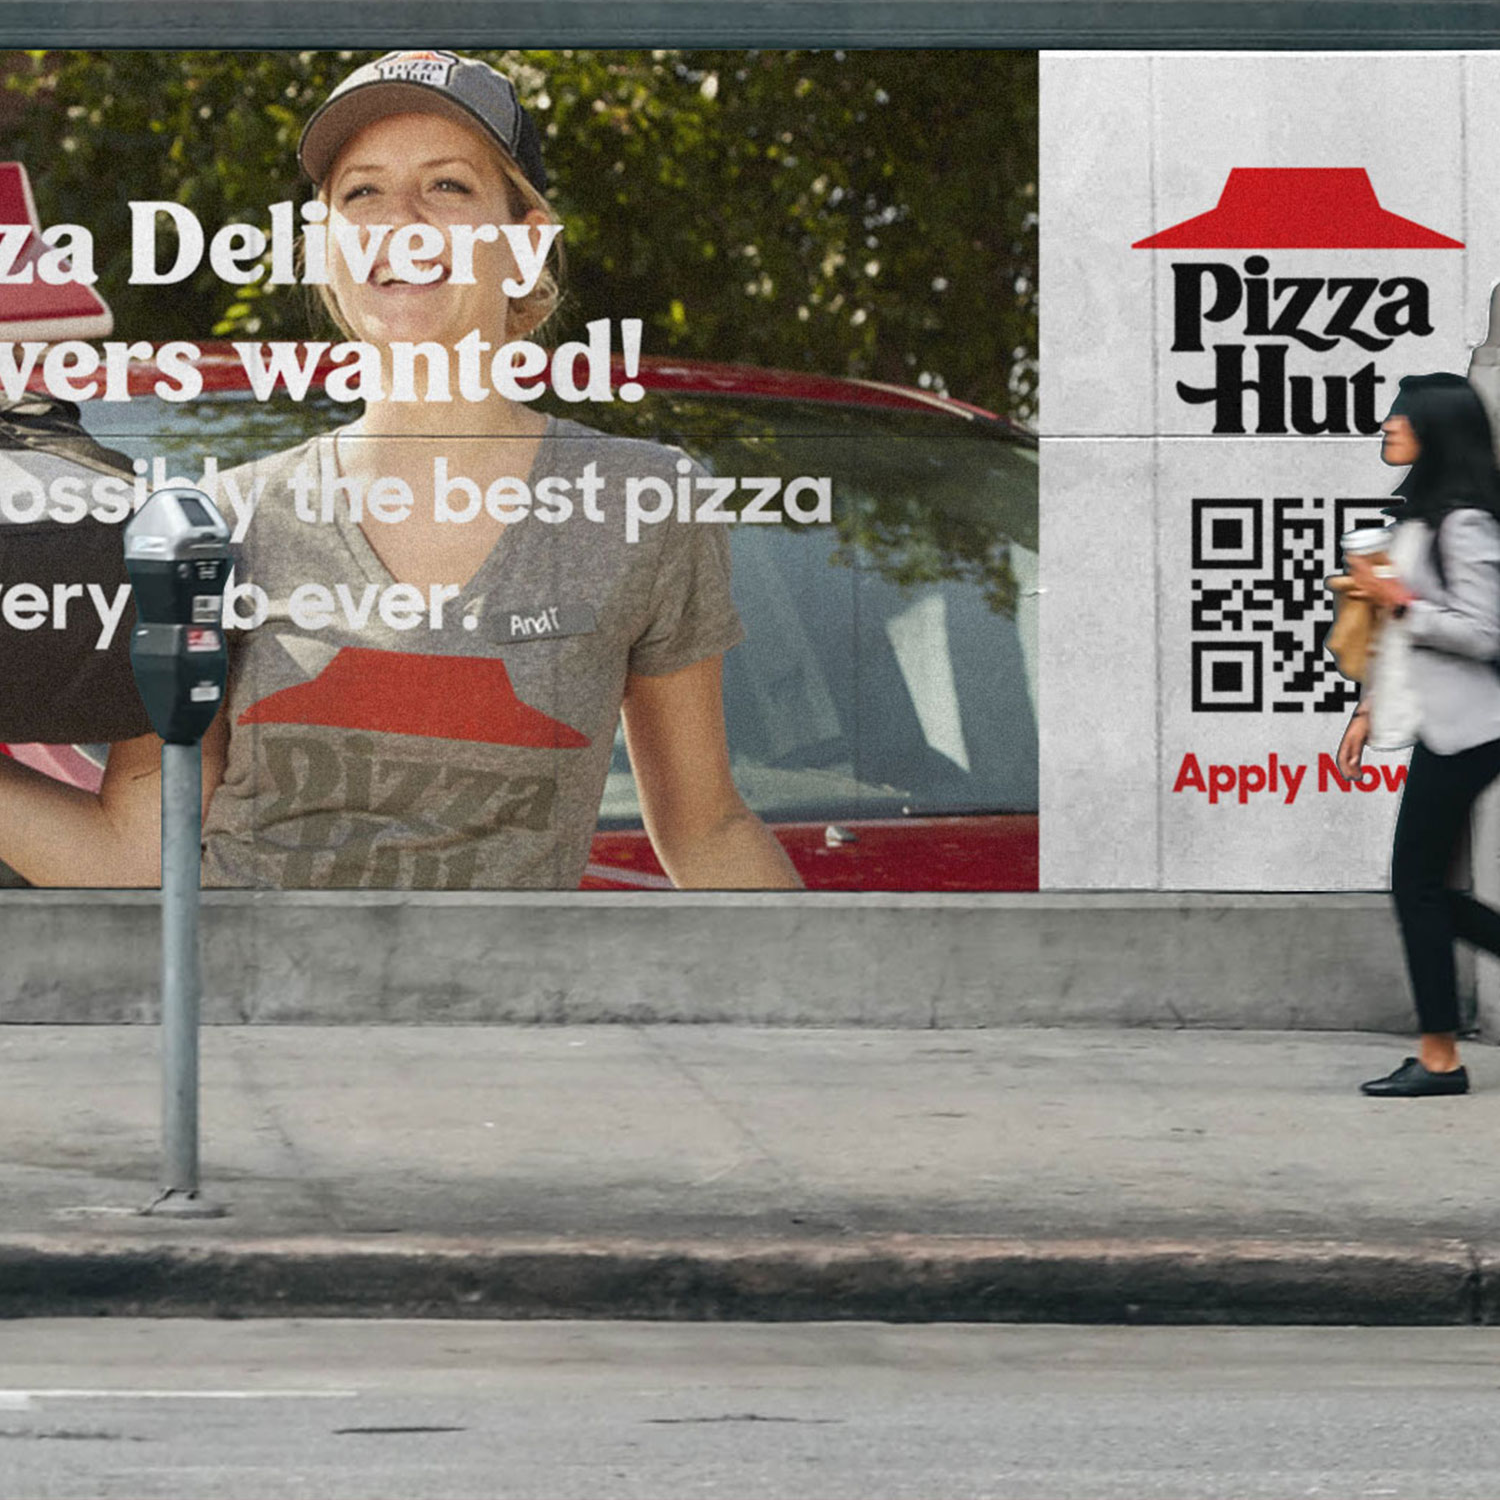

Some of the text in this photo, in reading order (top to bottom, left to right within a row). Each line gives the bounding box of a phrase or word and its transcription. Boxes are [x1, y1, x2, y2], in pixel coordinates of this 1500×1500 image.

[128, 200, 564, 298] Delivery
[1170, 255, 1435, 353] Pizza
[232, 317, 646, 403] wanted!
[1175, 344, 1386, 435] Hut
[288, 457, 415, 525] the
[433, 456, 606, 525] best
[625, 459, 832, 543] pizza
[288, 583, 479, 631] ever.
[1172, 752, 1307, 805] Apply
